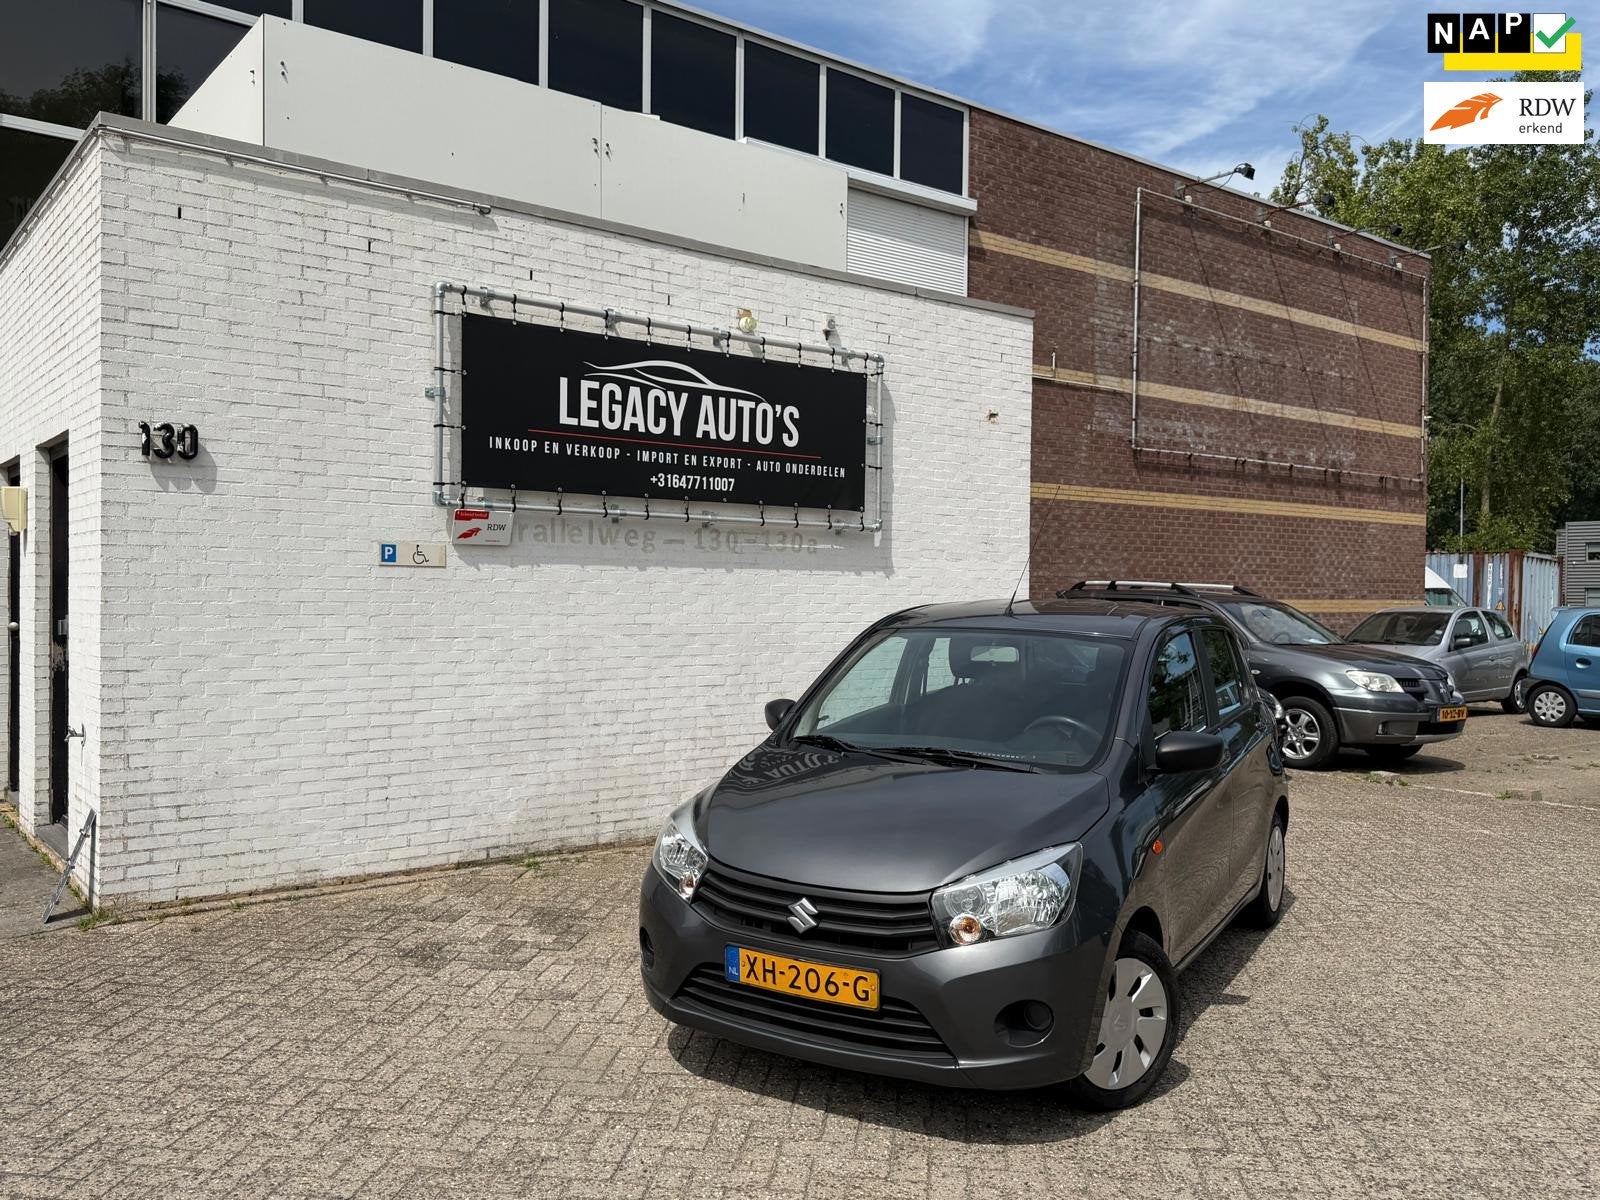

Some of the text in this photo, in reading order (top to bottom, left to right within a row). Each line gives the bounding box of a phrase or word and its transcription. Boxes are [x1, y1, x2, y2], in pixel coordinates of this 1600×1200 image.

[559, 376, 801, 448] LEGACY AUTO'S
[138, 420, 199, 460] 130
[489, 435, 538, 452] INKOOP
[544, 441, 559, 455] EN
[566, 443, 620, 460] VERKOOP
[637, 450, 679, 465] IMPORT
[684, 454, 697, 466] EN
[703, 455, 743, 470] EXPORT
[756, 460, 781, 473] AUTO
[785, 462, 846, 478] ONDERDELEN
[650, 473, 735, 491] +31647711007
[487, 523, 507, 532] RDW
[518, 517, 657, 553] rallelweg
[384, 546, 394, 560] P
[728, 966, 739, 976] NL
[745, 954, 870, 1002] XH-206-G
